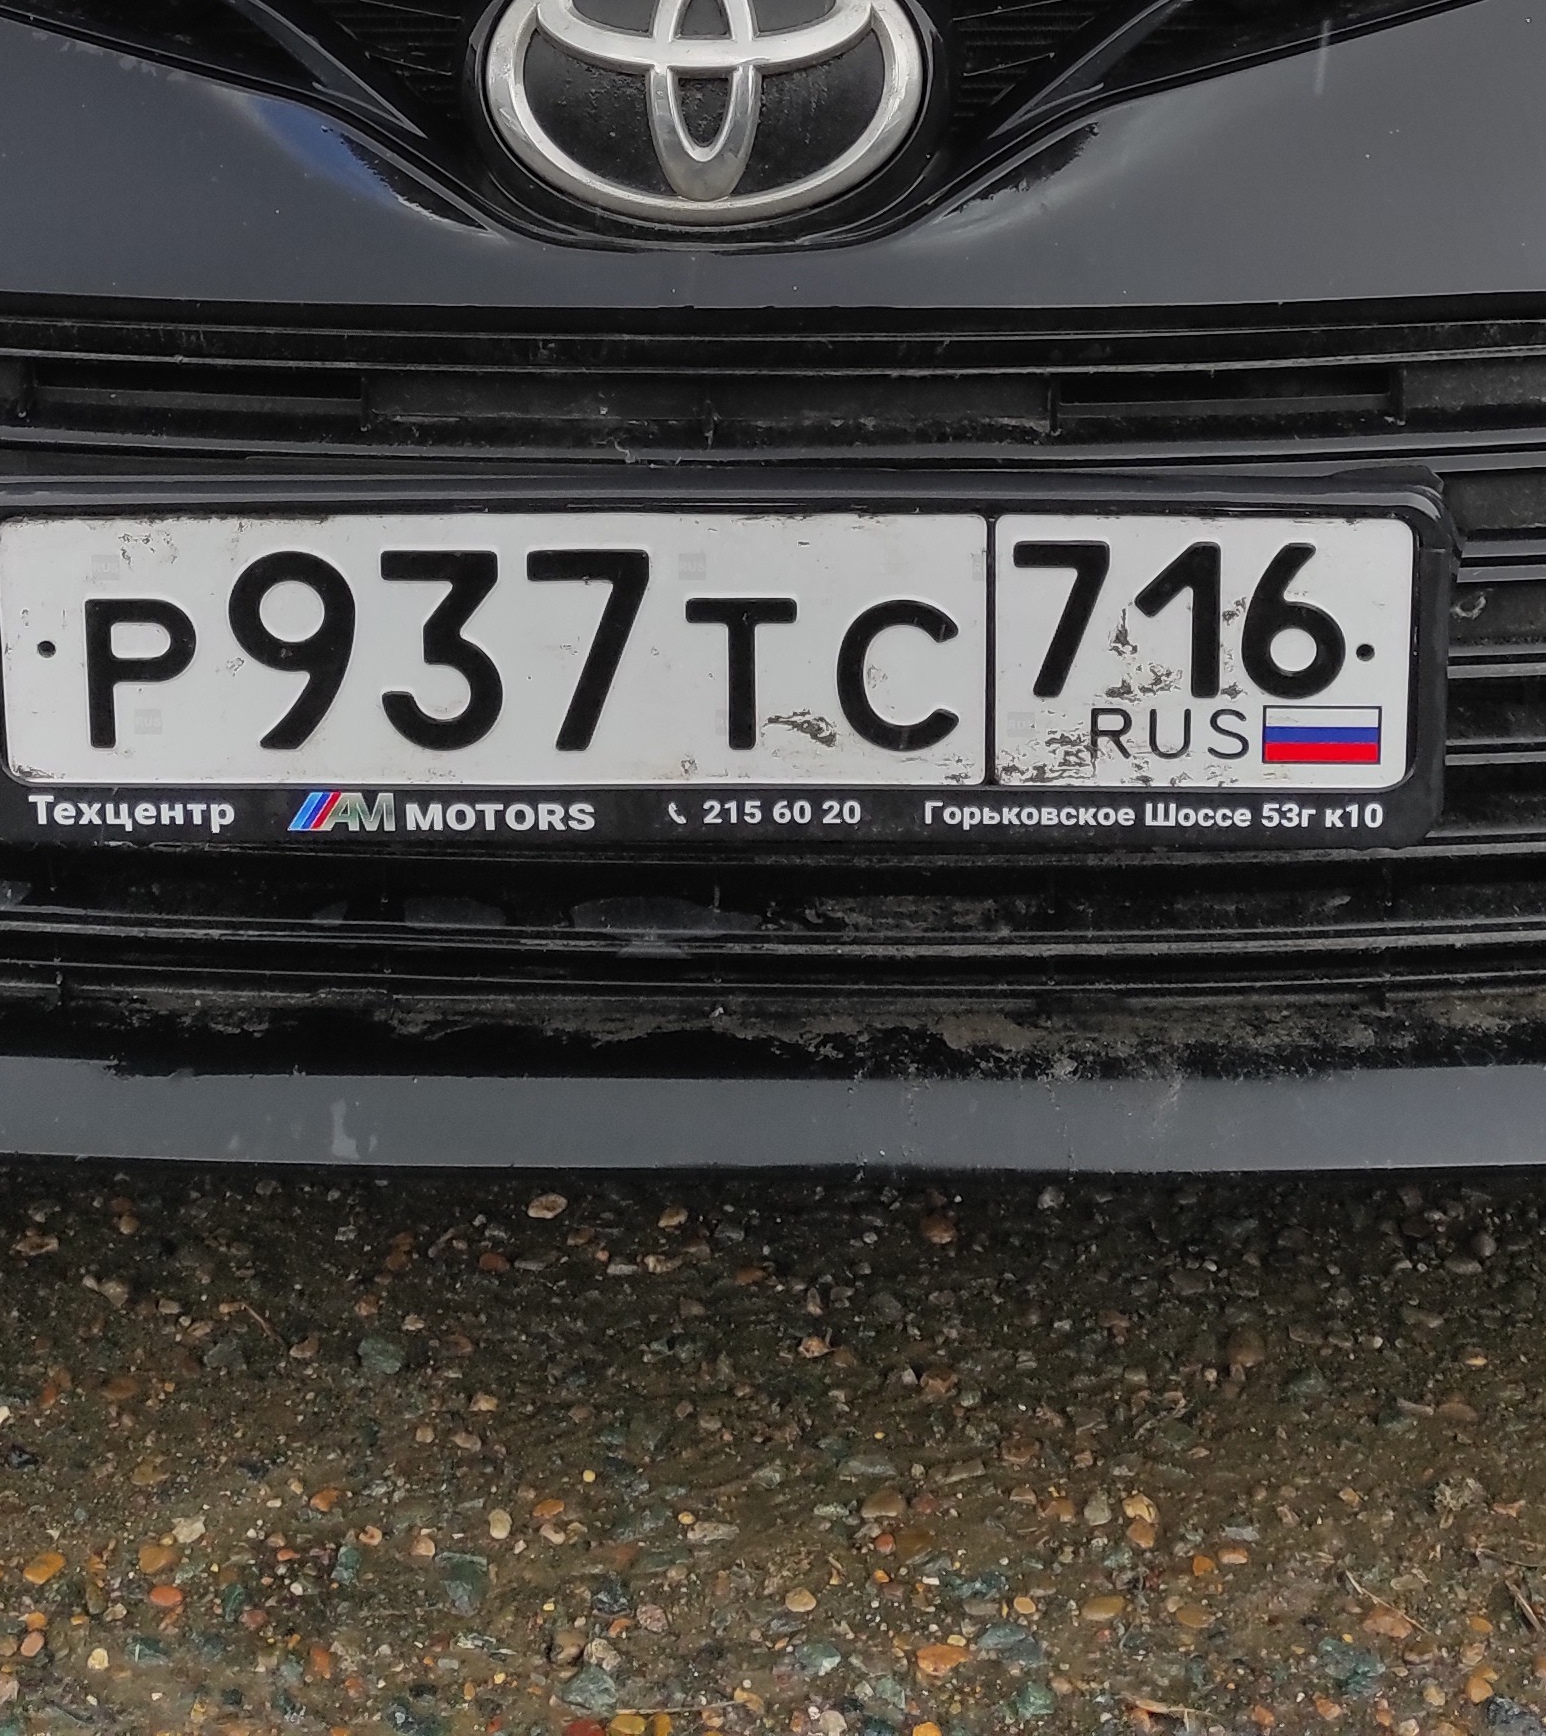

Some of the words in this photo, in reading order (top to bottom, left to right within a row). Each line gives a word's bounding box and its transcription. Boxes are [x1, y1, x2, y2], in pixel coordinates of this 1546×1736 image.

[1014, 540, 1345, 699] 716
[1091, 708, 1249, 759] RUS
[28, 795, 235, 833] Техцентр
[406, 803, 595, 831] MOTORS
[703, 800, 762, 824] 215
[773, 800, 812, 824] 60
[822, 800, 861, 824] 20
[925, 801, 1136, 830] Горьковское
[1145, 802, 1252, 827] Шоссе
[1261, 803, 1317, 828] 53г
[1325, 803, 1384, 828] к10
